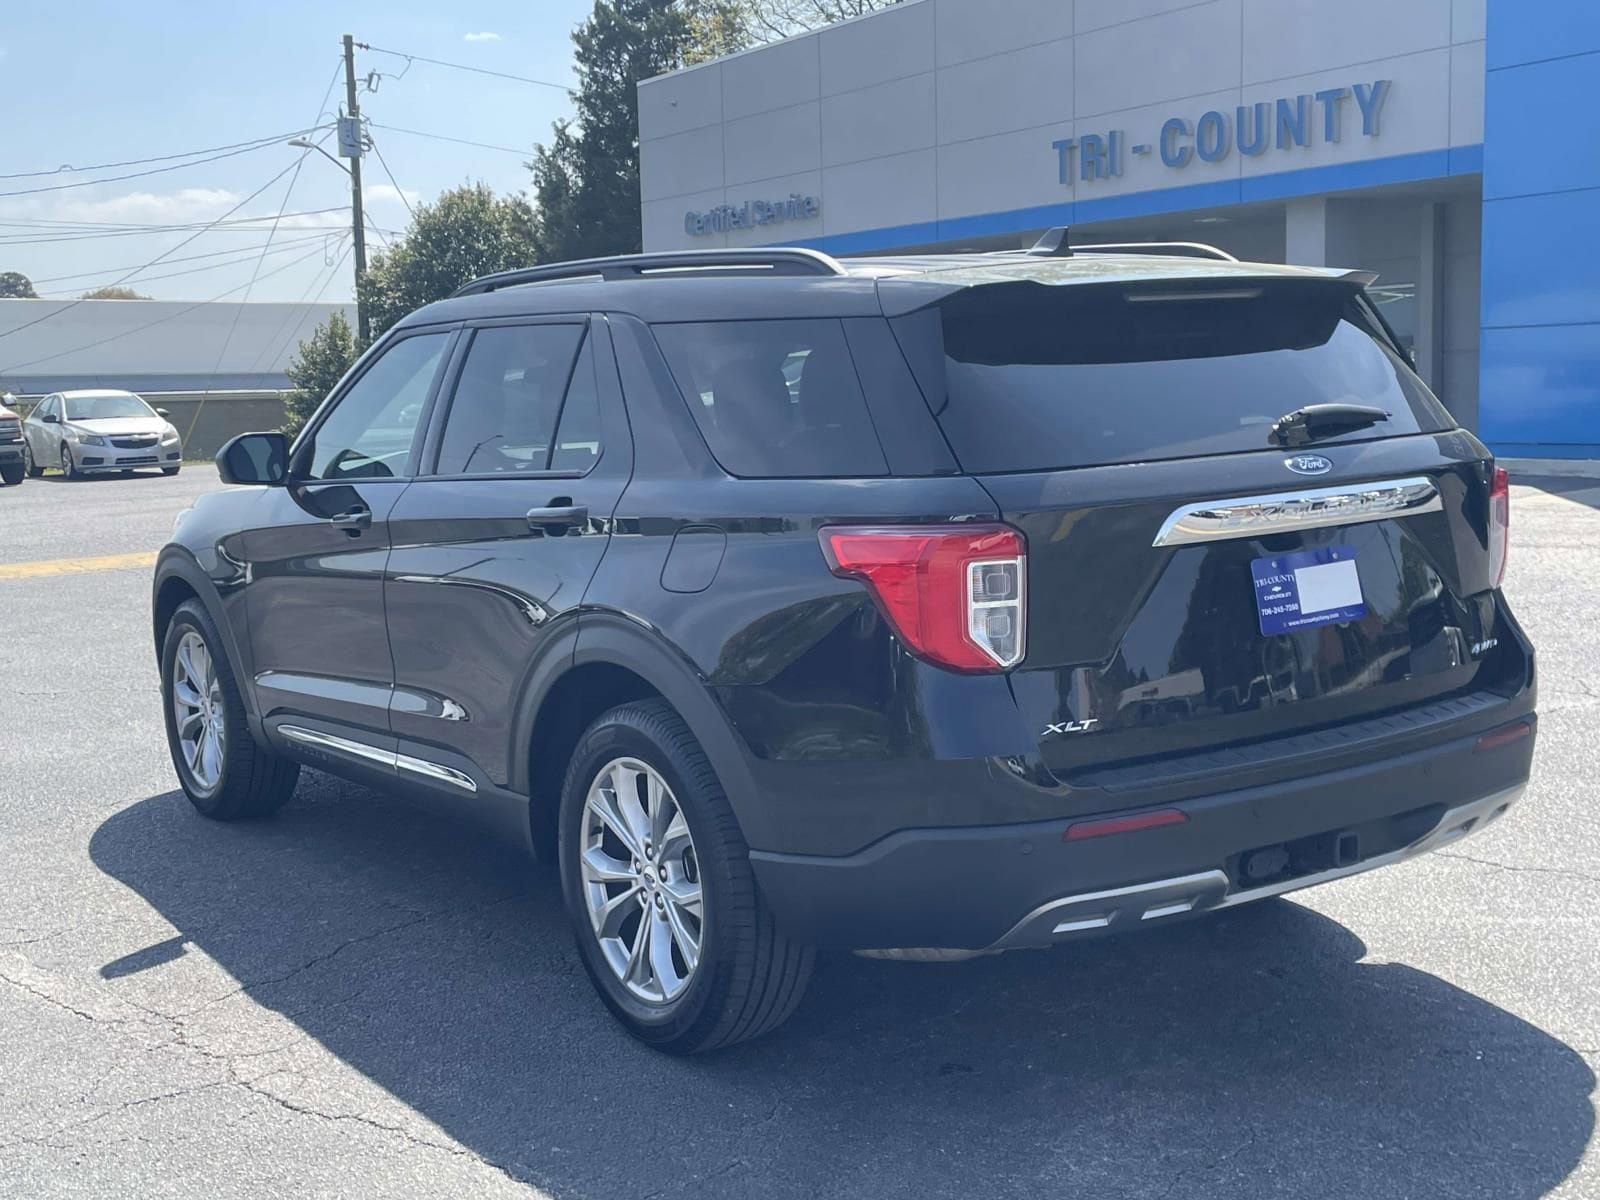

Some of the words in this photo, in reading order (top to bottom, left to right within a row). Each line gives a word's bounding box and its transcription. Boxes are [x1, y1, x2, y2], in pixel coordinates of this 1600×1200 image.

[1052, 80, 1391, 185] TRI-COUNTY
[685, 200, 749, 235] Certified
[1298, 457, 1325, 472] Ford
[1041, 718, 1098, 736] XLT
